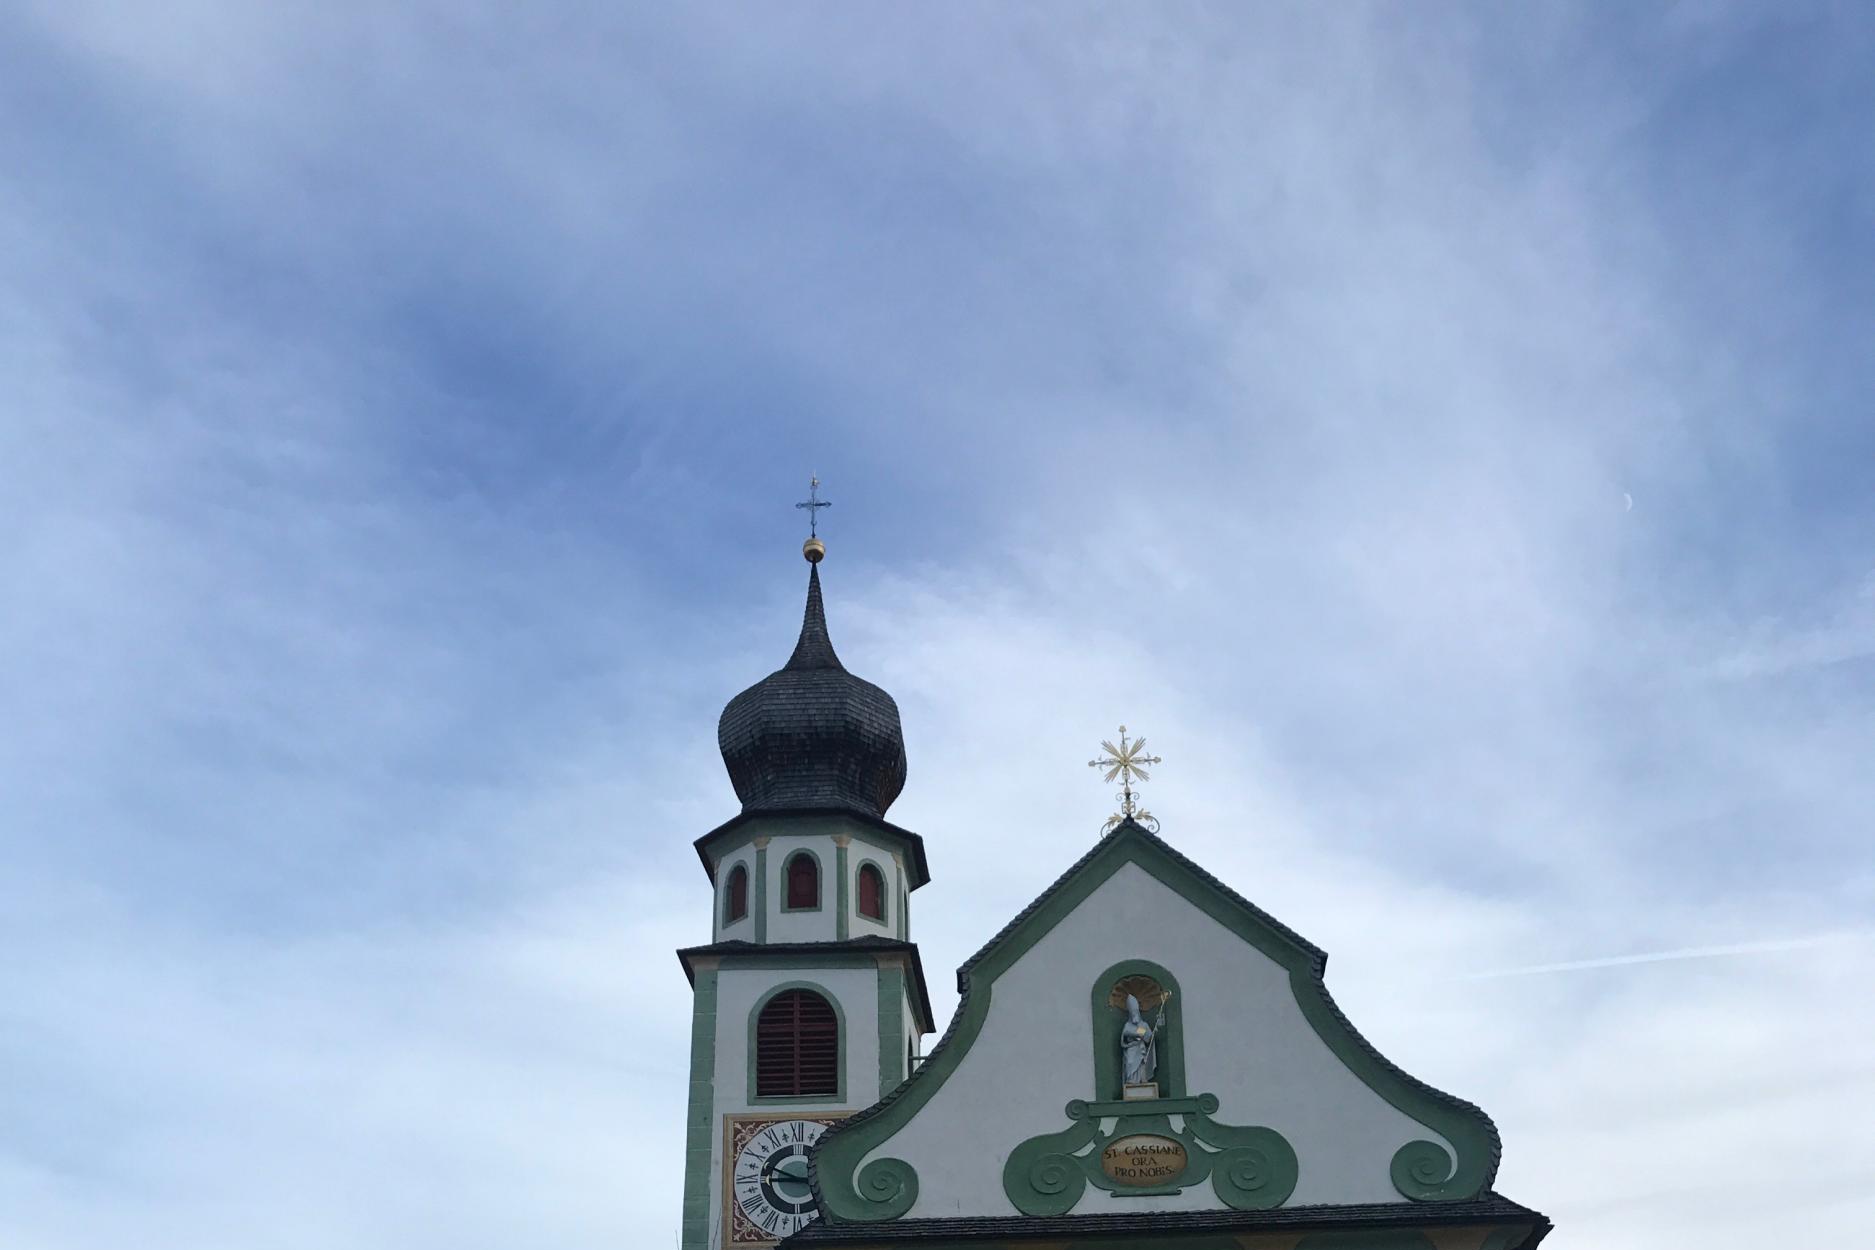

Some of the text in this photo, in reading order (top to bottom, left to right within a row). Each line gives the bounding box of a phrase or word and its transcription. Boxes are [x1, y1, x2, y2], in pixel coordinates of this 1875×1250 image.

[790, 1121, 804, 1142] XII
[763, 1127, 781, 1149] XI
[744, 1147, 766, 1162] X
[1125, 1144, 1181, 1156] CASSIANE
[1132, 1156, 1157, 1166] ORA
[1115, 1166, 1136, 1178] PRO
[736, 1174, 758, 1184] IX
